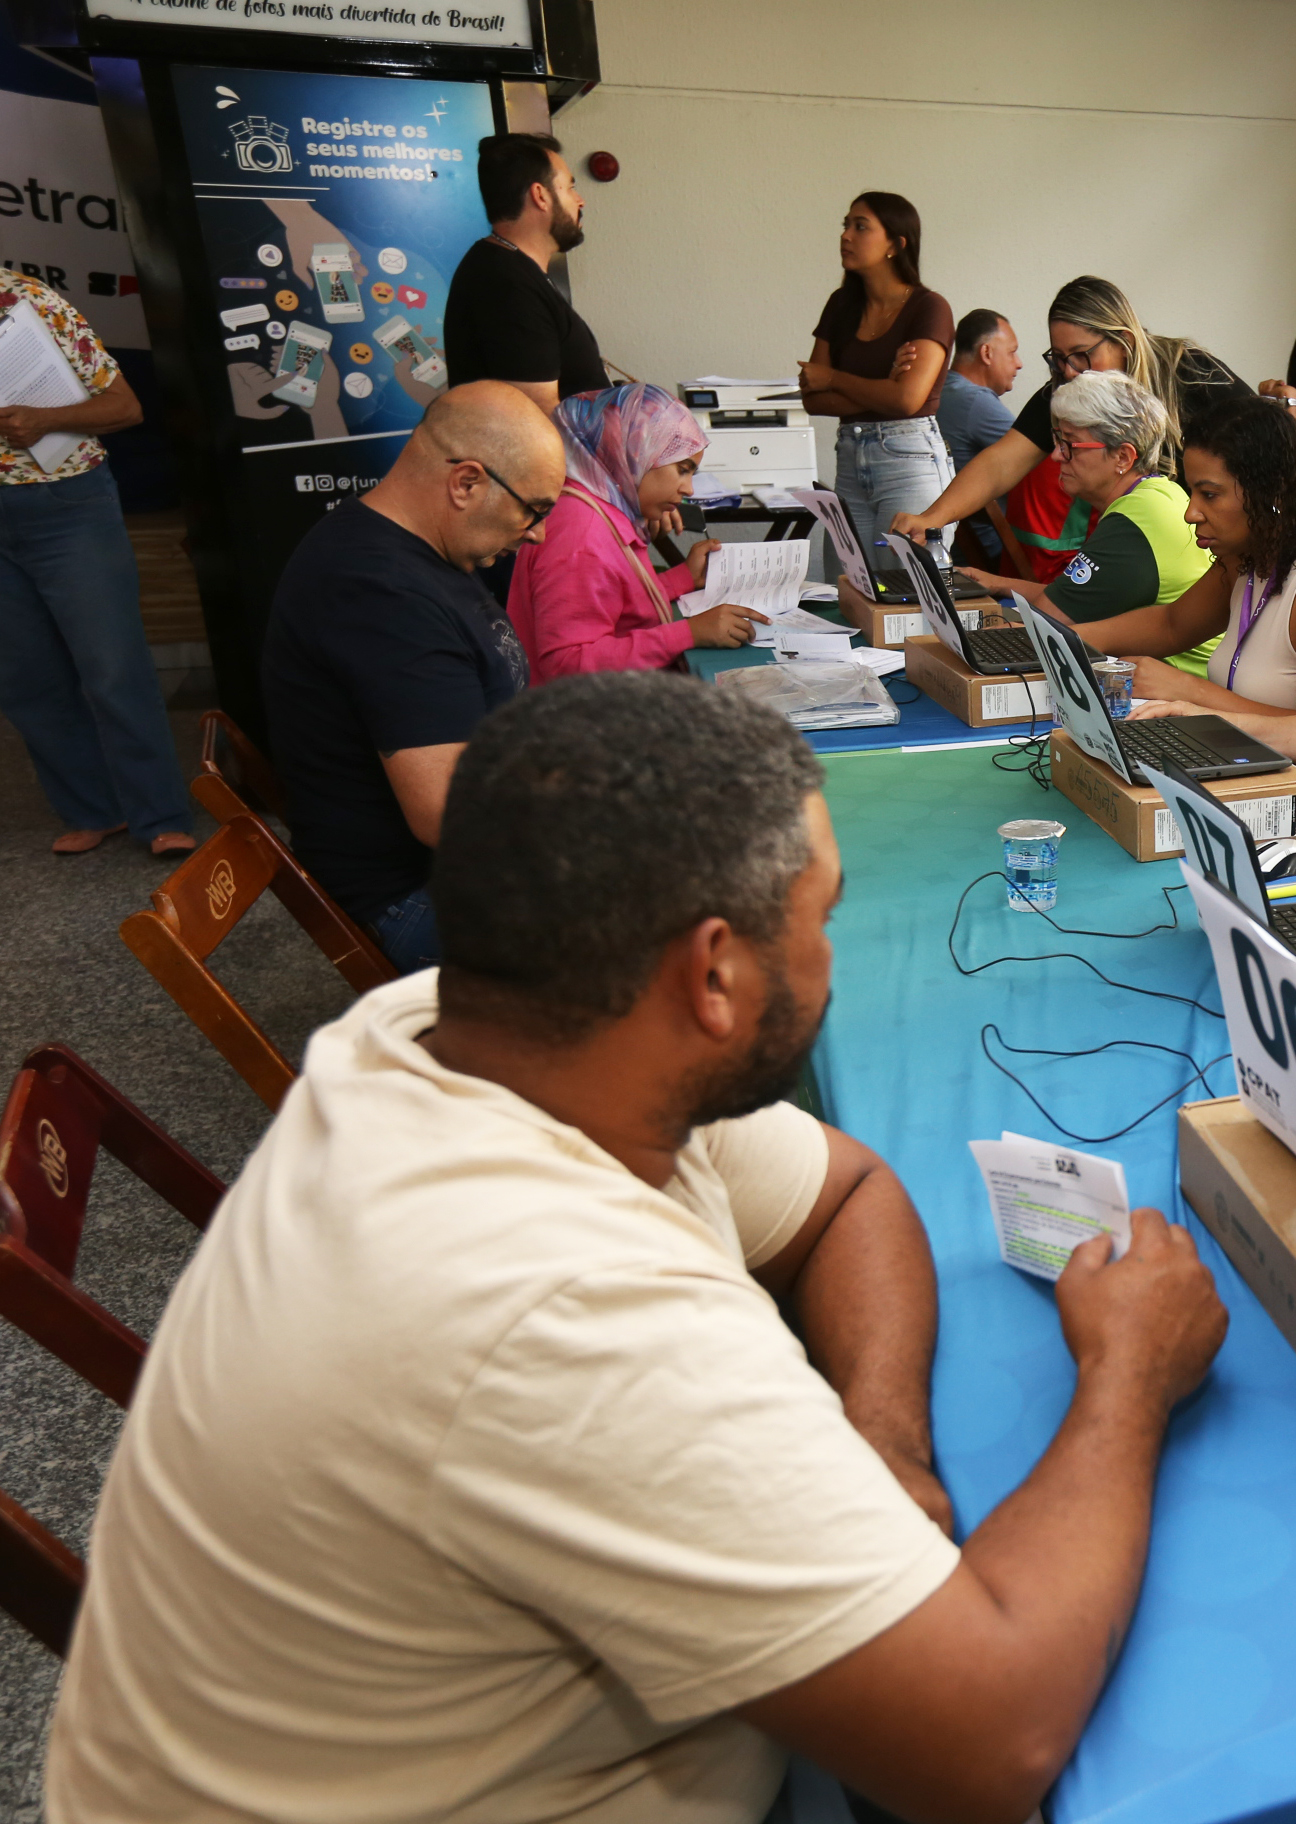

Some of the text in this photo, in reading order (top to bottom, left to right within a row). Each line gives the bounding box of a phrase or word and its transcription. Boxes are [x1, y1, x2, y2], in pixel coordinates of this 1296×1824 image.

[244, 0, 286, 18] fotos
[293, 4, 334, 21] mais
[340, 7, 416, 27] divertida
[422, 12, 441, 28] do
[449, 10, 505, 32] Brasil!
[302, 117, 428, 141] Registre os
[306, 142, 464, 162] seus melhores
[309, 163, 433, 183] momentos!
[0, 177, 128, 233] etra
[1175, 796, 1239, 899] 07
[205, 869, 237, 908] WB
